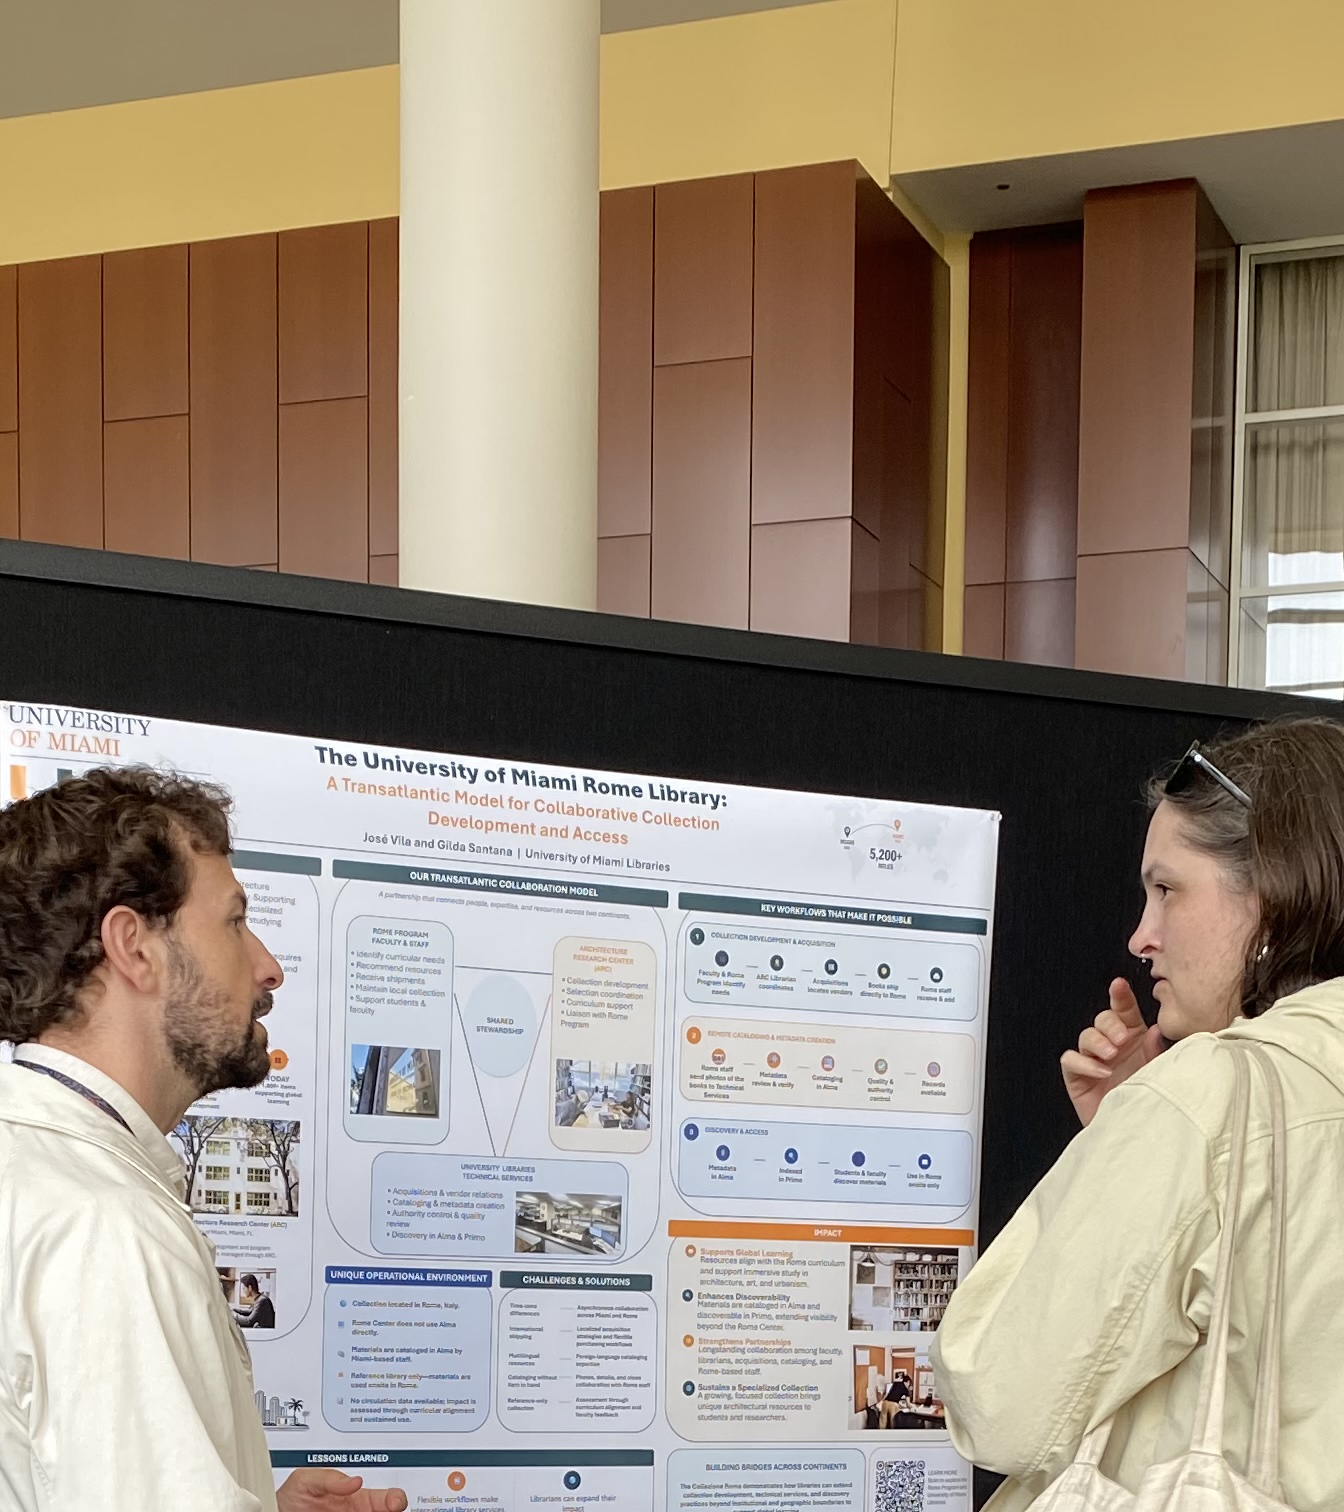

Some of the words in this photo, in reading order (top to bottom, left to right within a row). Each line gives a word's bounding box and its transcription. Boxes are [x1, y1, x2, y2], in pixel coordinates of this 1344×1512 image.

[9, 704, 152, 737] UNIVERSITY
[11, 728, 40, 750] OF
[48, 730, 121, 757] MIAMI
[315, 745, 356, 767] The
[363, 751, 477, 784] University
[484, 765, 505, 784] of
[511, 767, 576, 791] Miami
[583, 776, 642, 798] Rome
[648, 782, 726, 811] Library:
[327, 775, 337, 791] A
[342, 777, 449, 803] Transatlantic
[455, 789, 503, 809] Model
[508, 795, 529, 811] for
[534, 798, 637, 823] Collaborative
[642, 809, 719, 831] Collection
[428, 810, 535, 838] Development
[540, 823, 568, 839] and
[573, 826, 627, 845] Access
[363, 831, 387, 845] José
[390, 834, 410, 847] Vila
[414, 837, 434, 849] and
[437, 838, 465, 852] Gilda
[469, 842, 512, 856] Santana
[525, 848, 577, 865] University
[580, 853, 590, 864] of
[593, 854, 623, 867] Miami
[627, 857, 669, 872] Libraries
[870, 847, 901, 863] 5,200+
[409, 870, 428, 881] OUR
[430, 872, 497, 887] TRANSATLANTIC
[498, 879, 568, 894] COLLABORATION
[568, 885, 598, 897] MODEL
[761, 903, 776, 913] KEY
[777, 904, 826, 917] WORKFLOWS
[827, 909, 846, 919] THAT
[847, 910, 867, 920] MAKE
[868, 912, 876, 921] IT
[876, 913, 911, 924] POSSIBLE
[814, 1227, 841, 1237] IMPACT
[330, 1269, 365, 1280] UNIQUE
[365, 1270, 424, 1281] OPERATIONAL
[426, 1272, 487, 1282] ENVIRONMENT
[521, 1275, 576, 1284] CHALLENGES
[576, 1276, 583, 1285] &
[585, 1276, 630, 1286] SOLUTIONS
[306, 1454, 347, 1462] LESSONS
[347, 1453, 389, 1462] LEARNED
